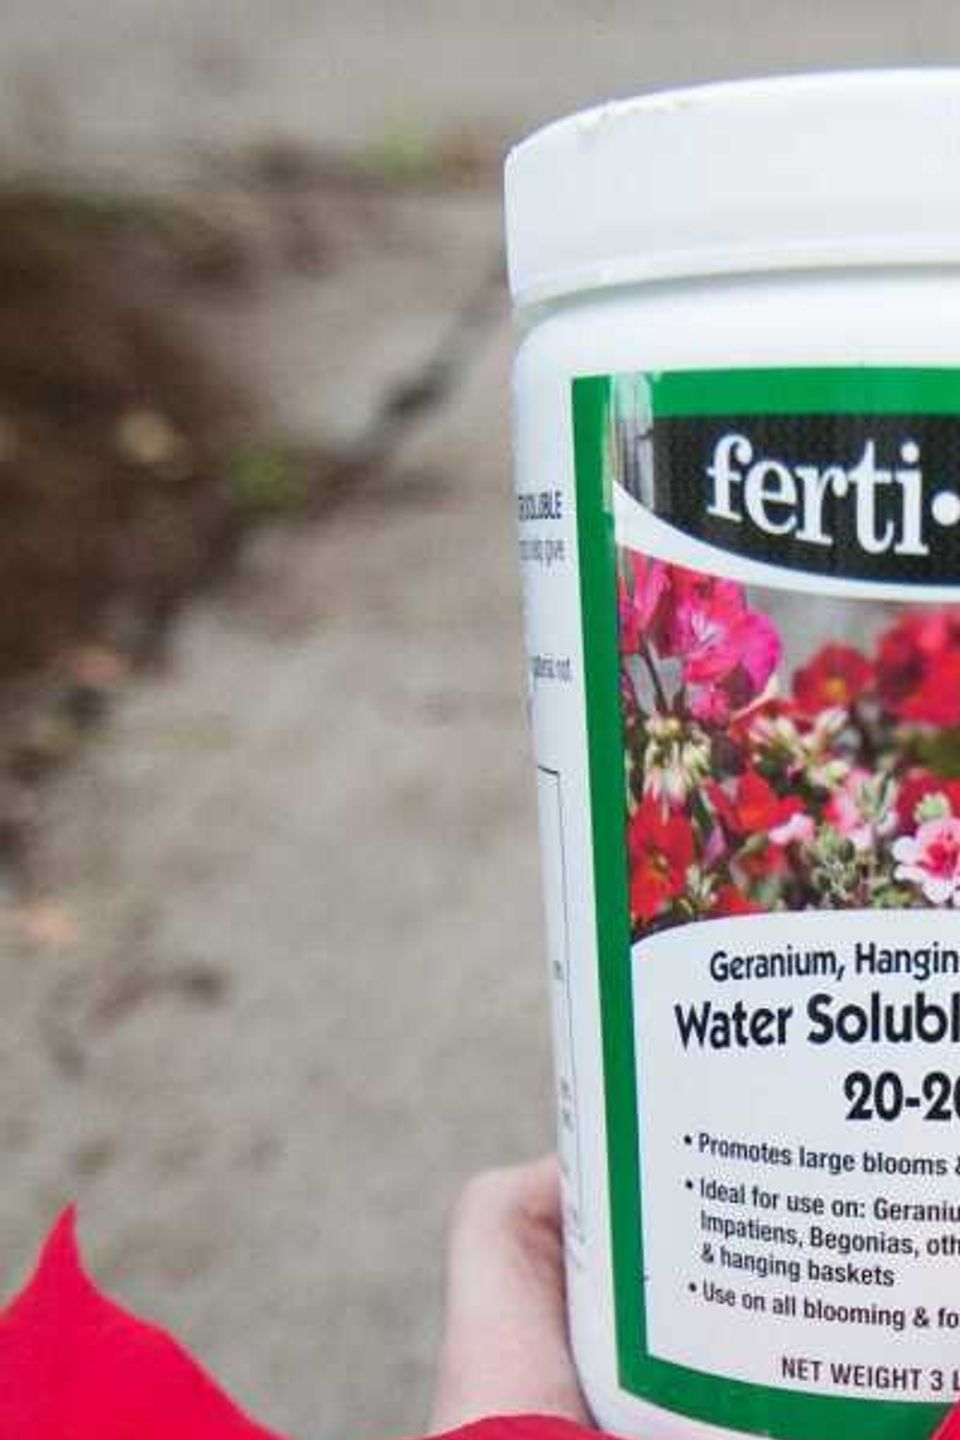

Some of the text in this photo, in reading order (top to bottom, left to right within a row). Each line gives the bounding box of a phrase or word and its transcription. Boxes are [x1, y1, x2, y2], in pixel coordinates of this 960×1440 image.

[710, 945, 844, 982] Geranium,
[674, 1001, 793, 1050] Water
[698, 1133, 791, 1166] Promotes
[800, 1147, 855, 1174] large
[863, 1152, 947, 1176] blooms
[700, 1178, 745, 1205] Ideal
[752, 1186, 780, 1210] for
[786, 1194, 824, 1216] use
[832, 1200, 866, 1218] on:
[700, 1211, 803, 1247] Impatiens,
[810, 1226, 919, 1258] Begonias,
[700, 1243, 895, 1287] & hanging baskets
[703, 1281, 736, 1306] Use
[742, 1294, 765, 1312] on
[772, 1295, 796, 1316] all
[804, 1299, 905, 1331] blooming
[912, 1306, 929, 1328] &
[782, 1356, 823, 1382] NET
[830, 1363, 922, 1390] WEIGHT
[930, 1368, 943, 1391] 3
